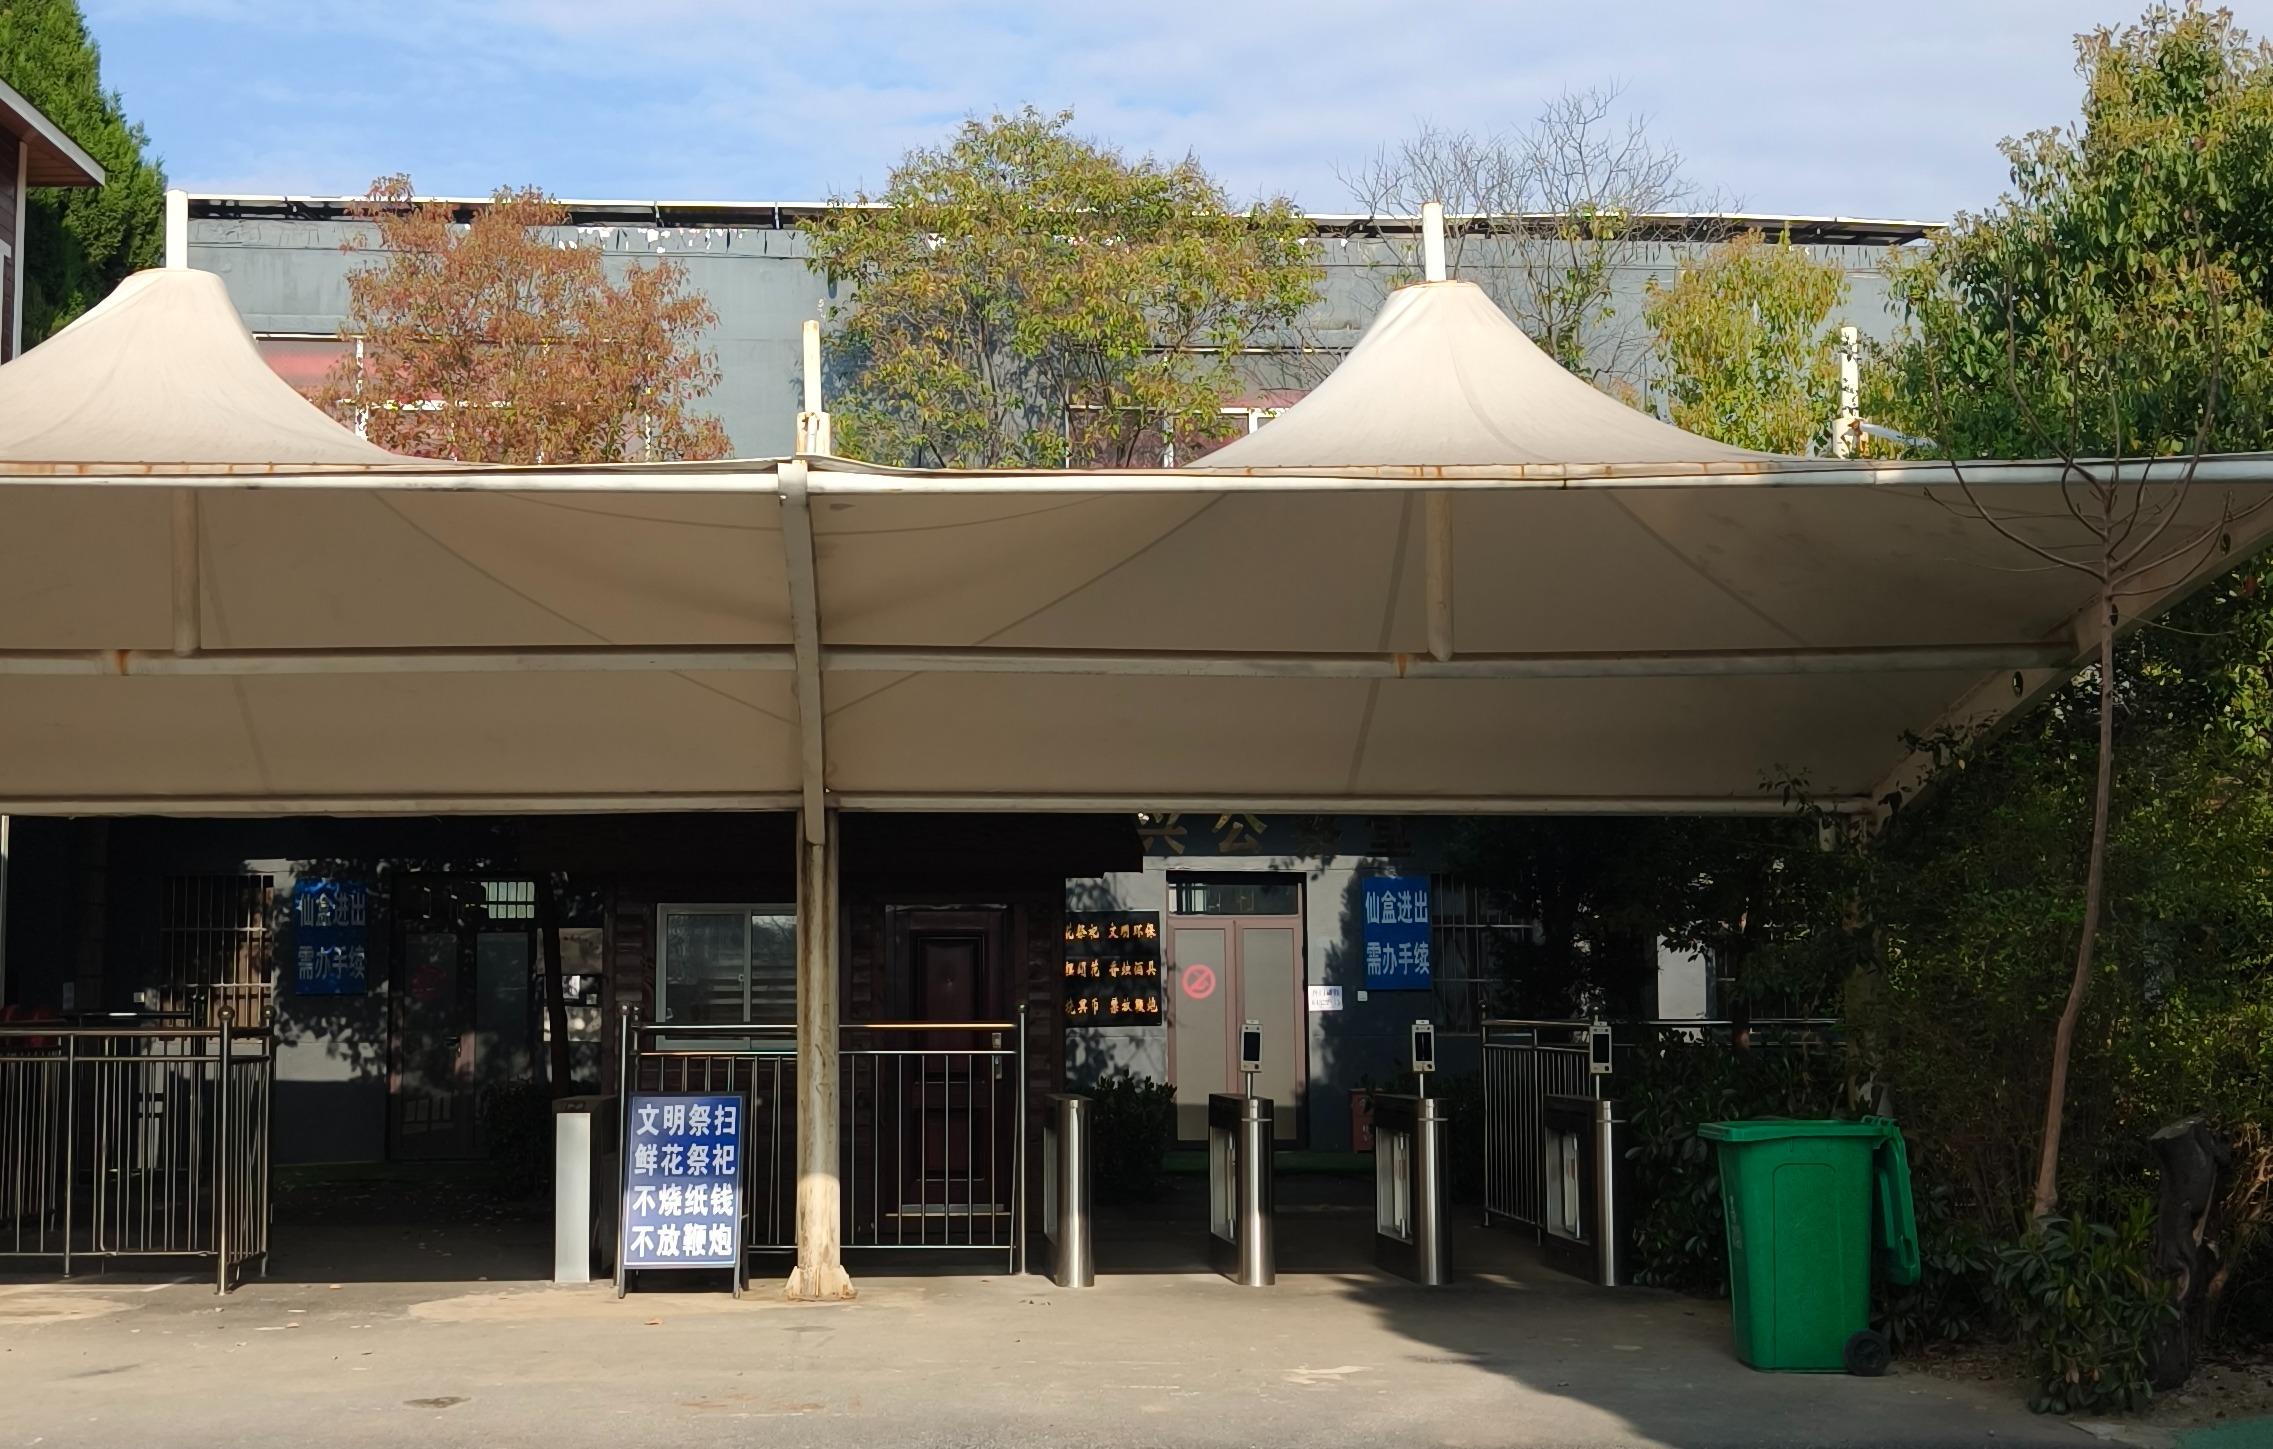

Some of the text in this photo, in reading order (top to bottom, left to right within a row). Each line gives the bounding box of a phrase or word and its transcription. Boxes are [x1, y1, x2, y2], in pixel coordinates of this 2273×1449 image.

[1365, 889, 1429, 924] 仙盒进出
[298, 945, 367, 980] 需办手续
[1366, 942, 1430, 976] 需办手续
[636, 1103, 737, 1136] 文明祭扫
[634, 1143, 735, 1177] 鲜花祭祀
[632, 1182, 734, 1217] 不烧纸钱
[630, 1223, 733, 1258] 不放鞭炮
